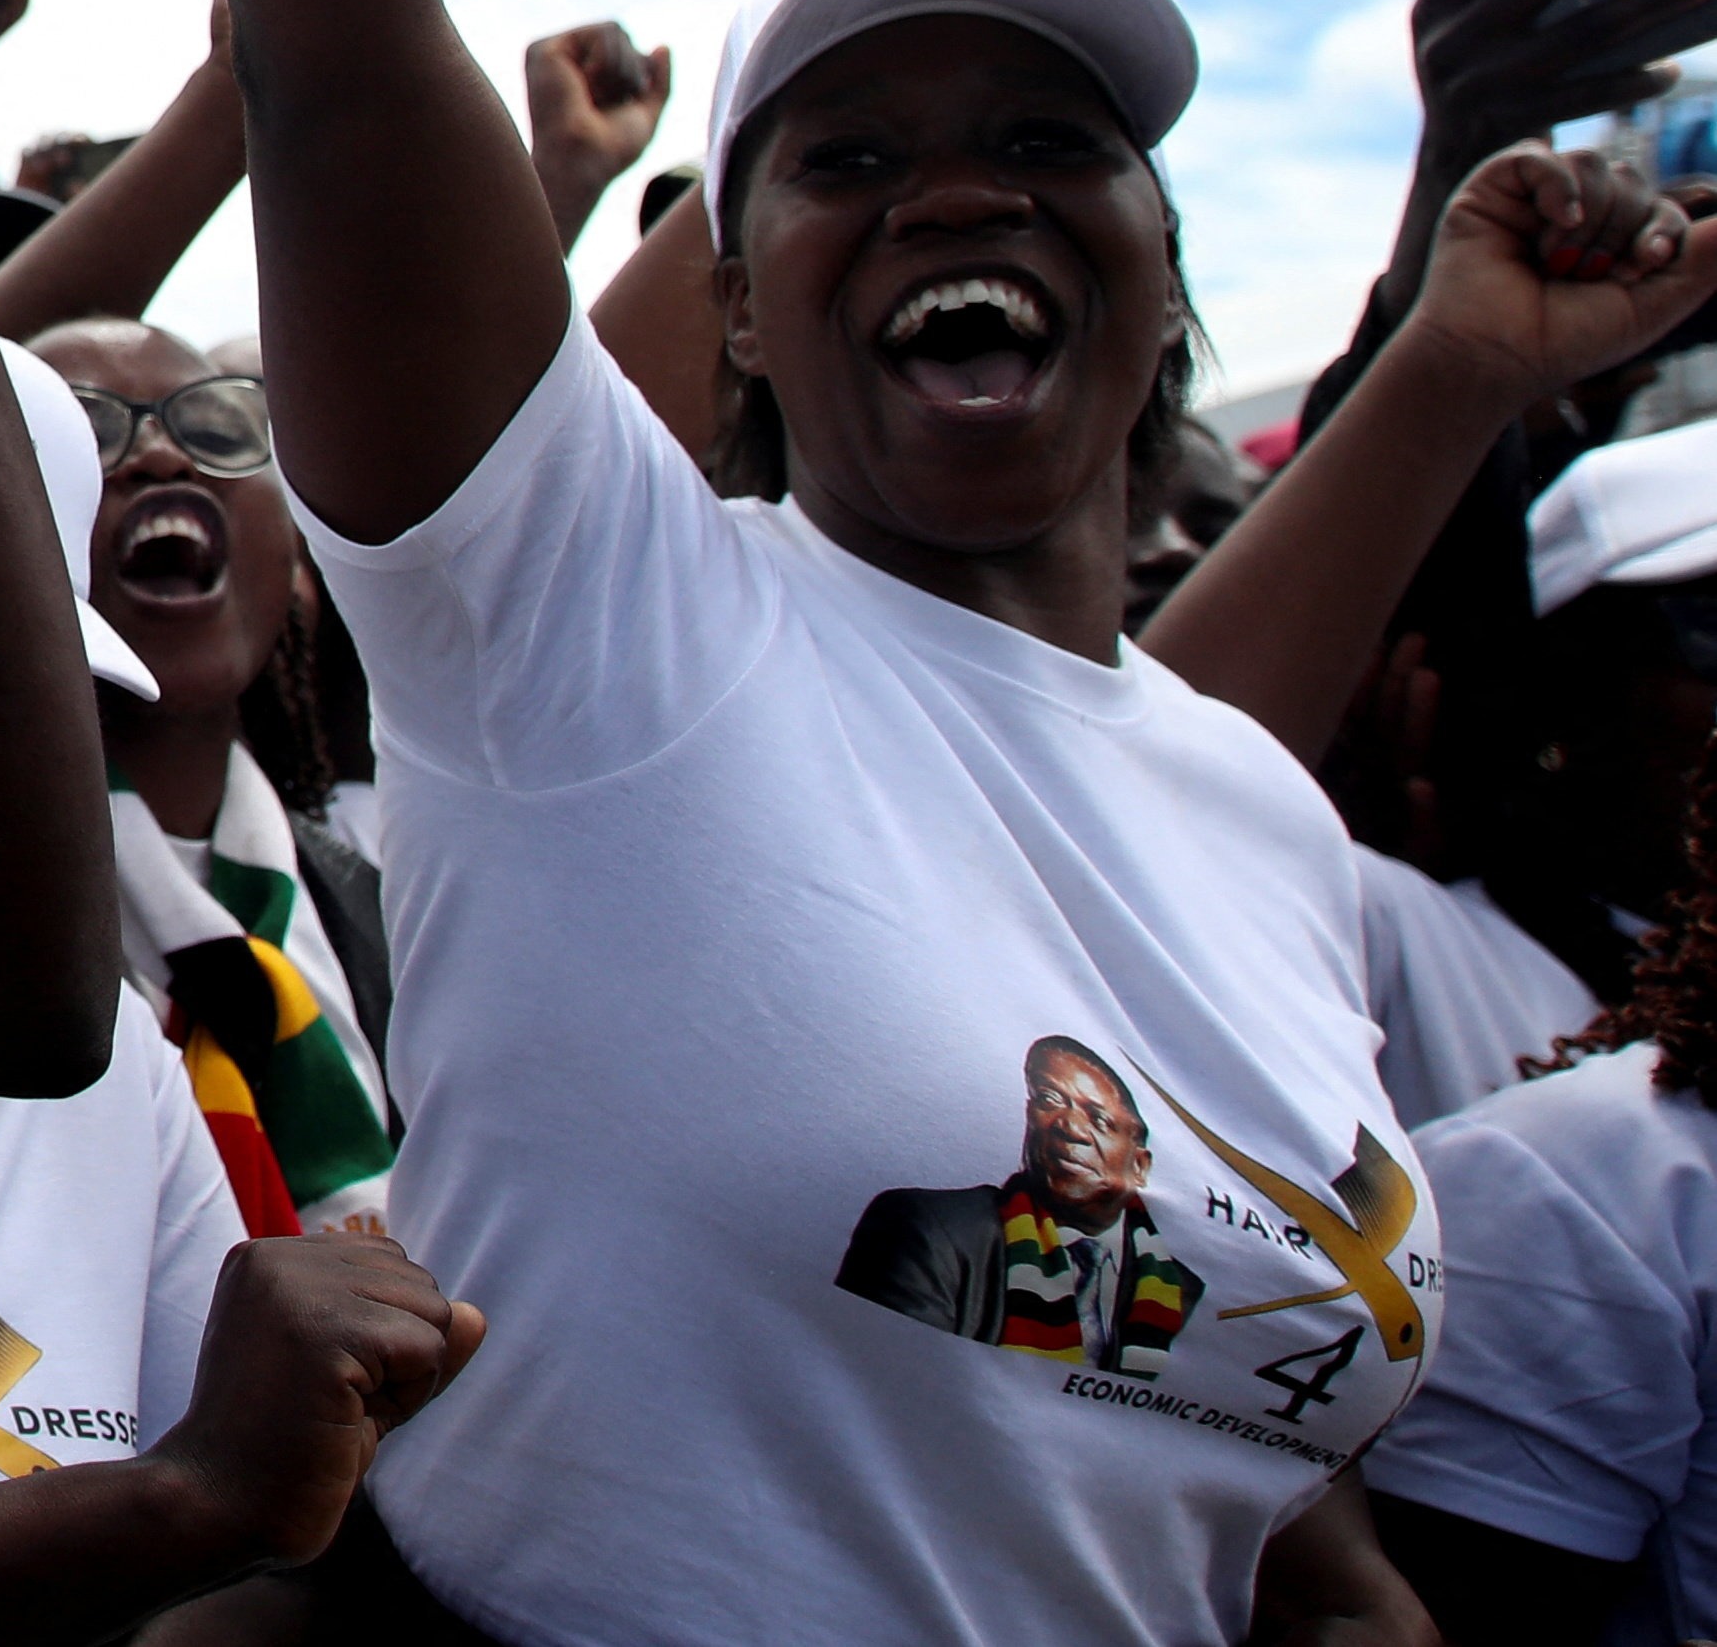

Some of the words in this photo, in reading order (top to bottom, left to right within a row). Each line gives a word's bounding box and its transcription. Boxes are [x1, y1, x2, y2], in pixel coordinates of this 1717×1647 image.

[1206, 1186, 1315, 1260] HAIR
[1061, 1373, 1198, 1422] ECONOMIC
[1198, 1407, 1348, 1470] DEVELOPMENT
[1255, 1324, 1364, 1425] 4
